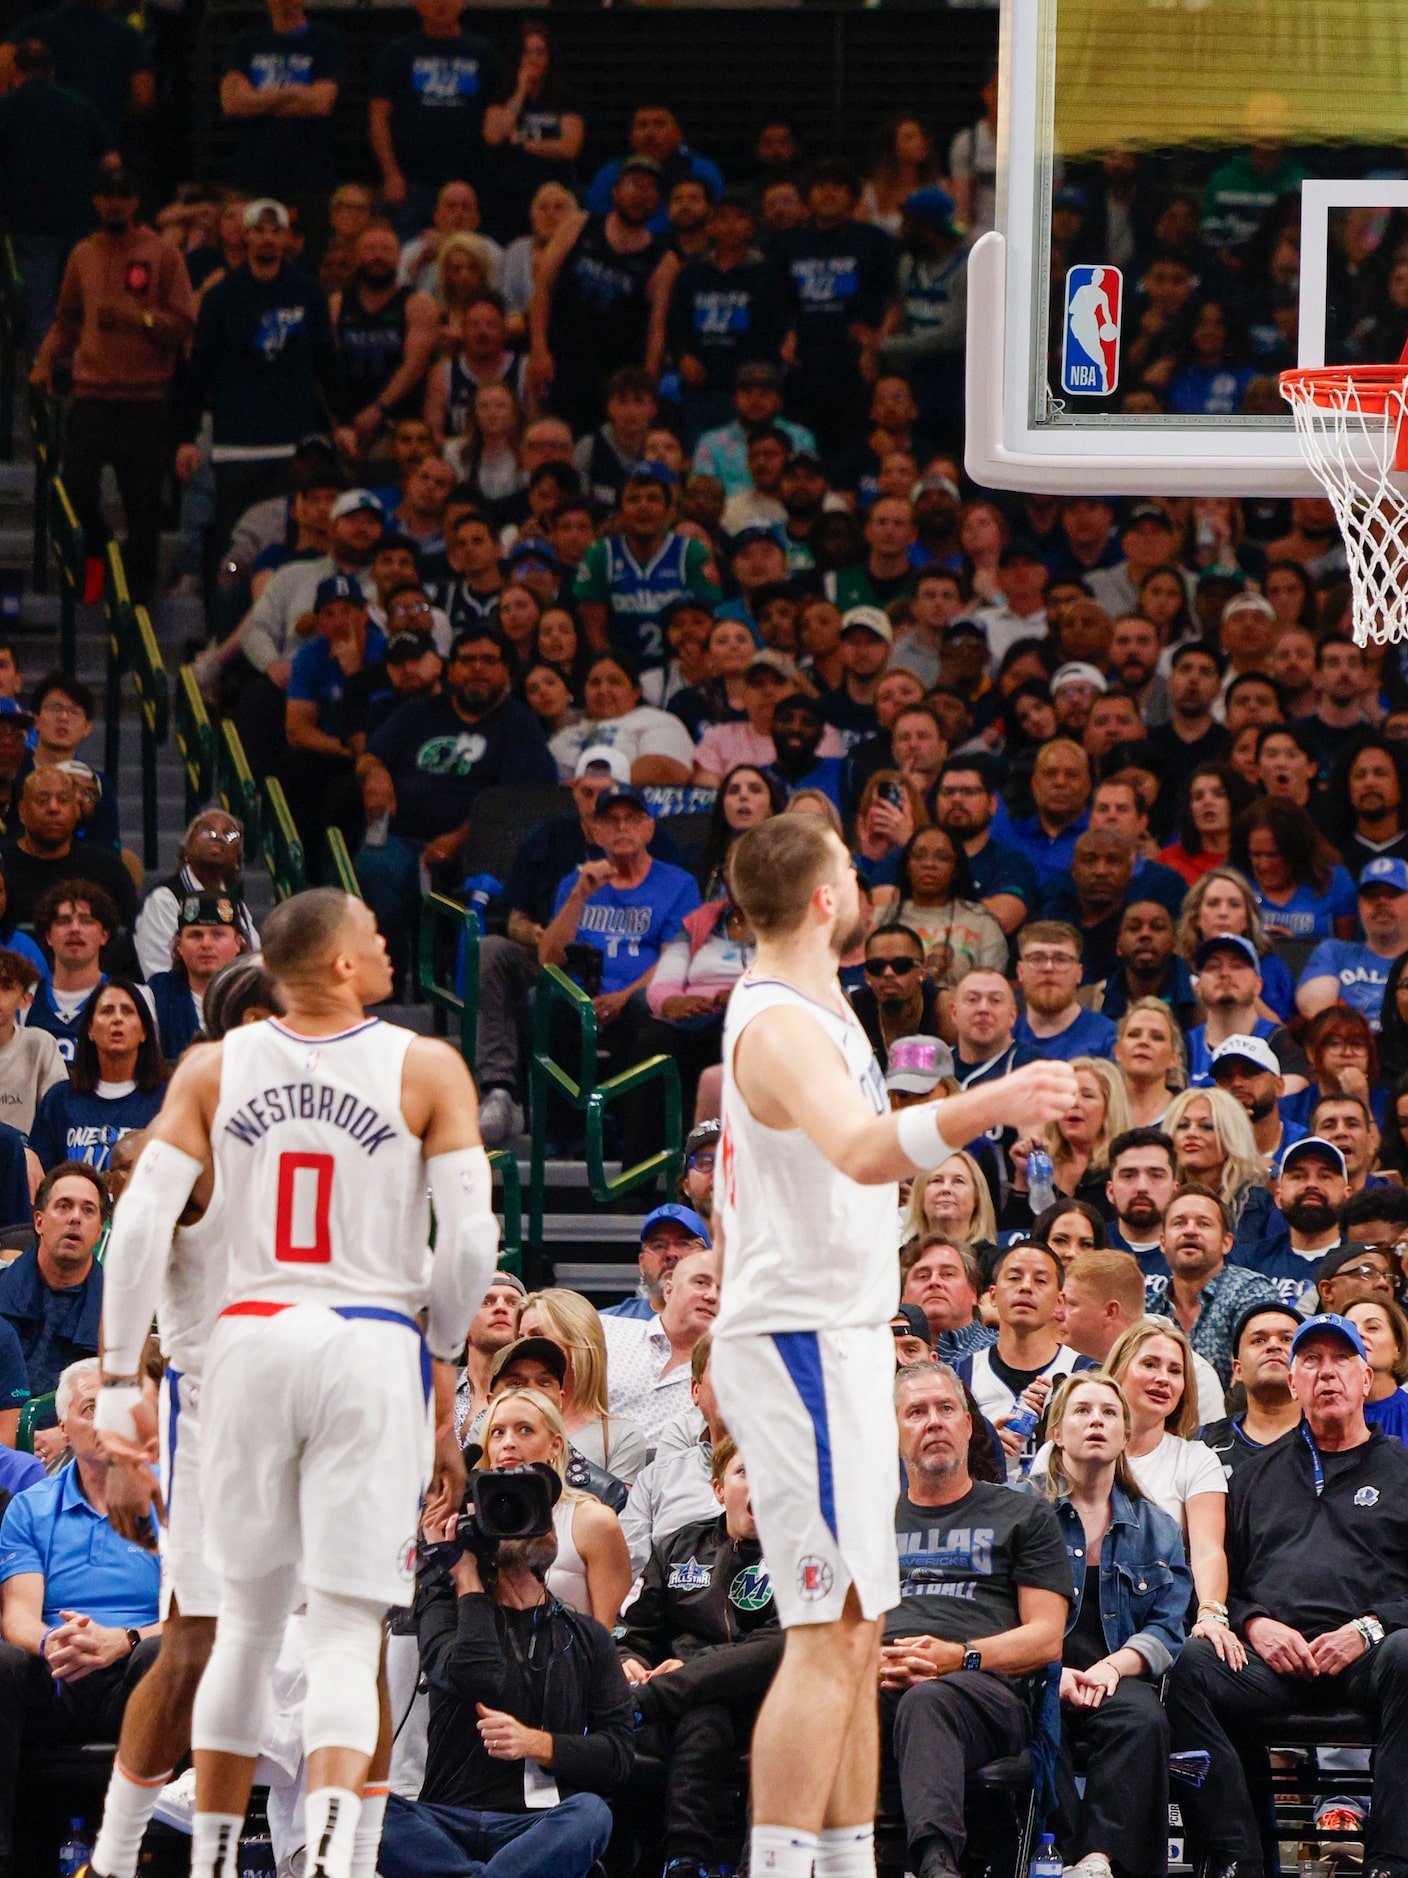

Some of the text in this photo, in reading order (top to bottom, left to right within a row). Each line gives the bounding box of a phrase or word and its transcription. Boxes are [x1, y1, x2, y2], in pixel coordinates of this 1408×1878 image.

[1070, 366, 1096, 386] NBA
[605, 936, 642, 958] 77
[1339, 966, 1389, 986] DAL
[224, 1083, 396, 1156] WESTBROOK
[66, 1126, 99, 1147] ONE
[275, 1151, 335, 1264] 0
[895, 1528, 995, 1576] LLAS
[898, 1556, 970, 1568] AVERICKS
